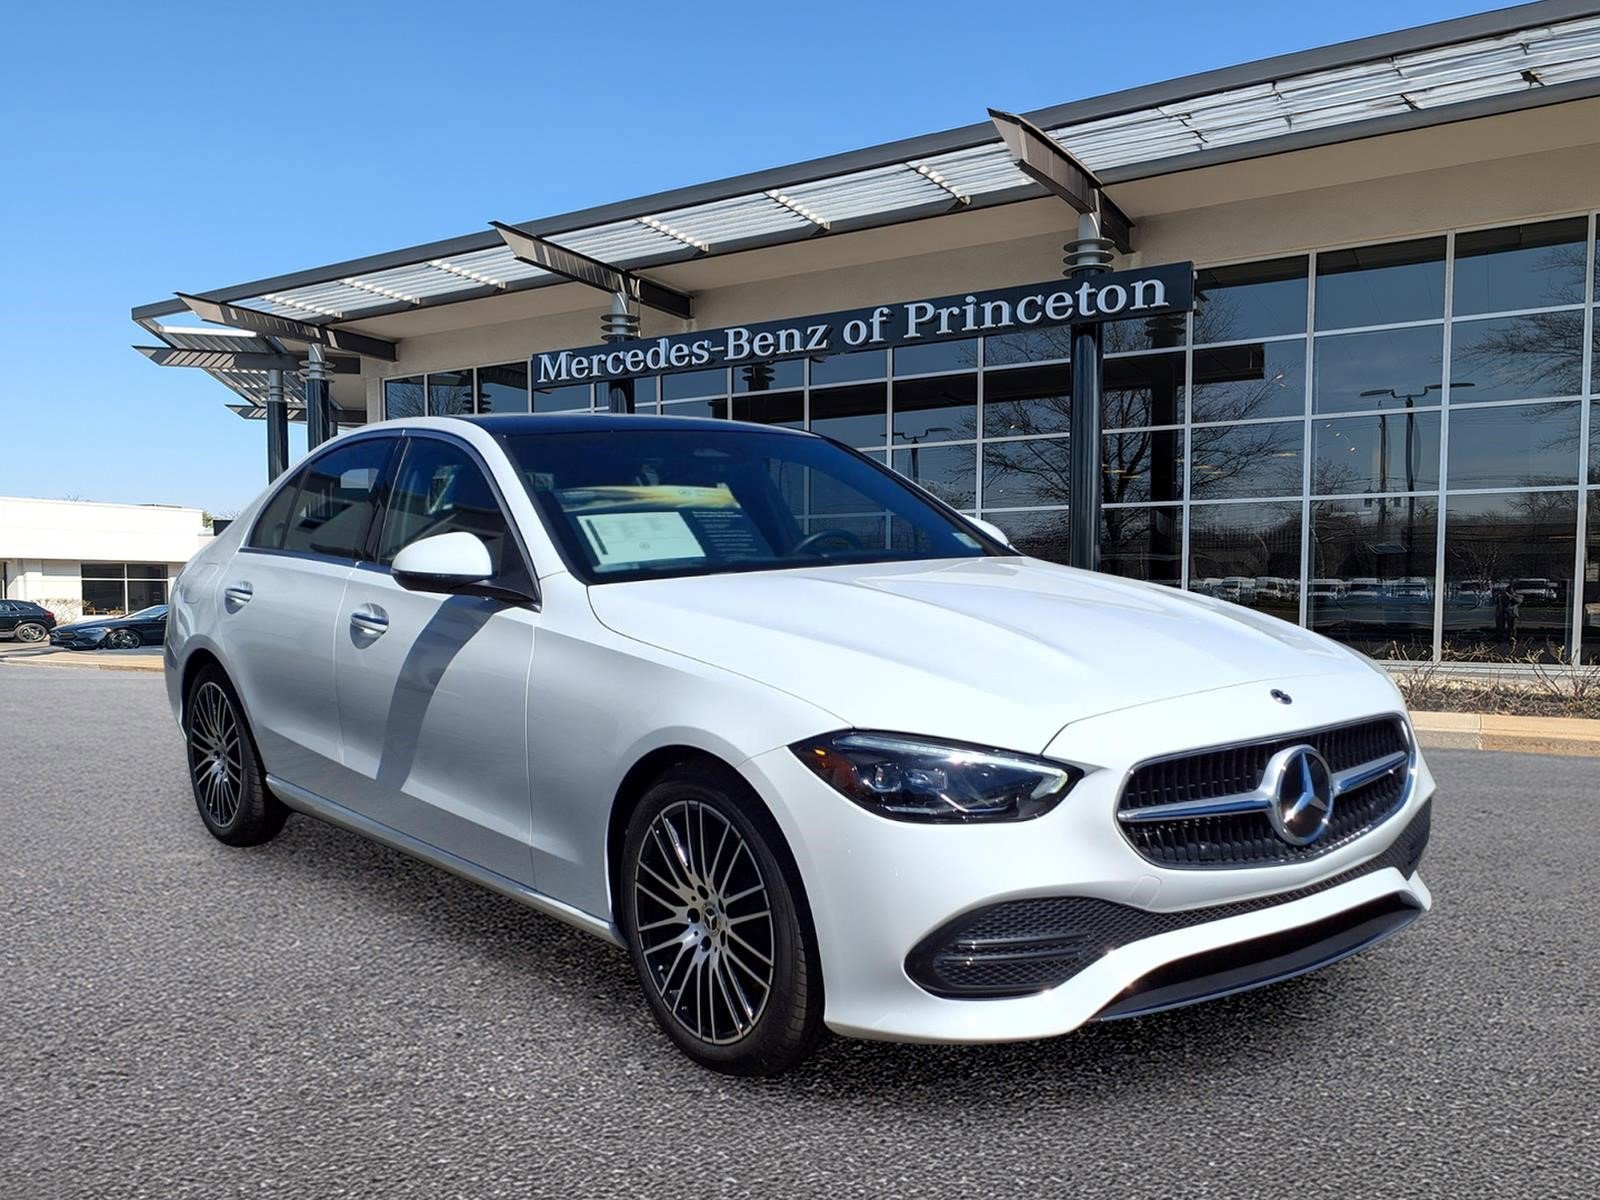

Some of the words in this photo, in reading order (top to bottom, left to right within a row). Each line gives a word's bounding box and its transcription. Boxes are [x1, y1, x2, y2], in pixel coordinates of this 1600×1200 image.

[537, 323, 829, 383] Mercedes-Benz
[843, 307, 890, 345] of
[903, 278, 1169, 339] Princeton
